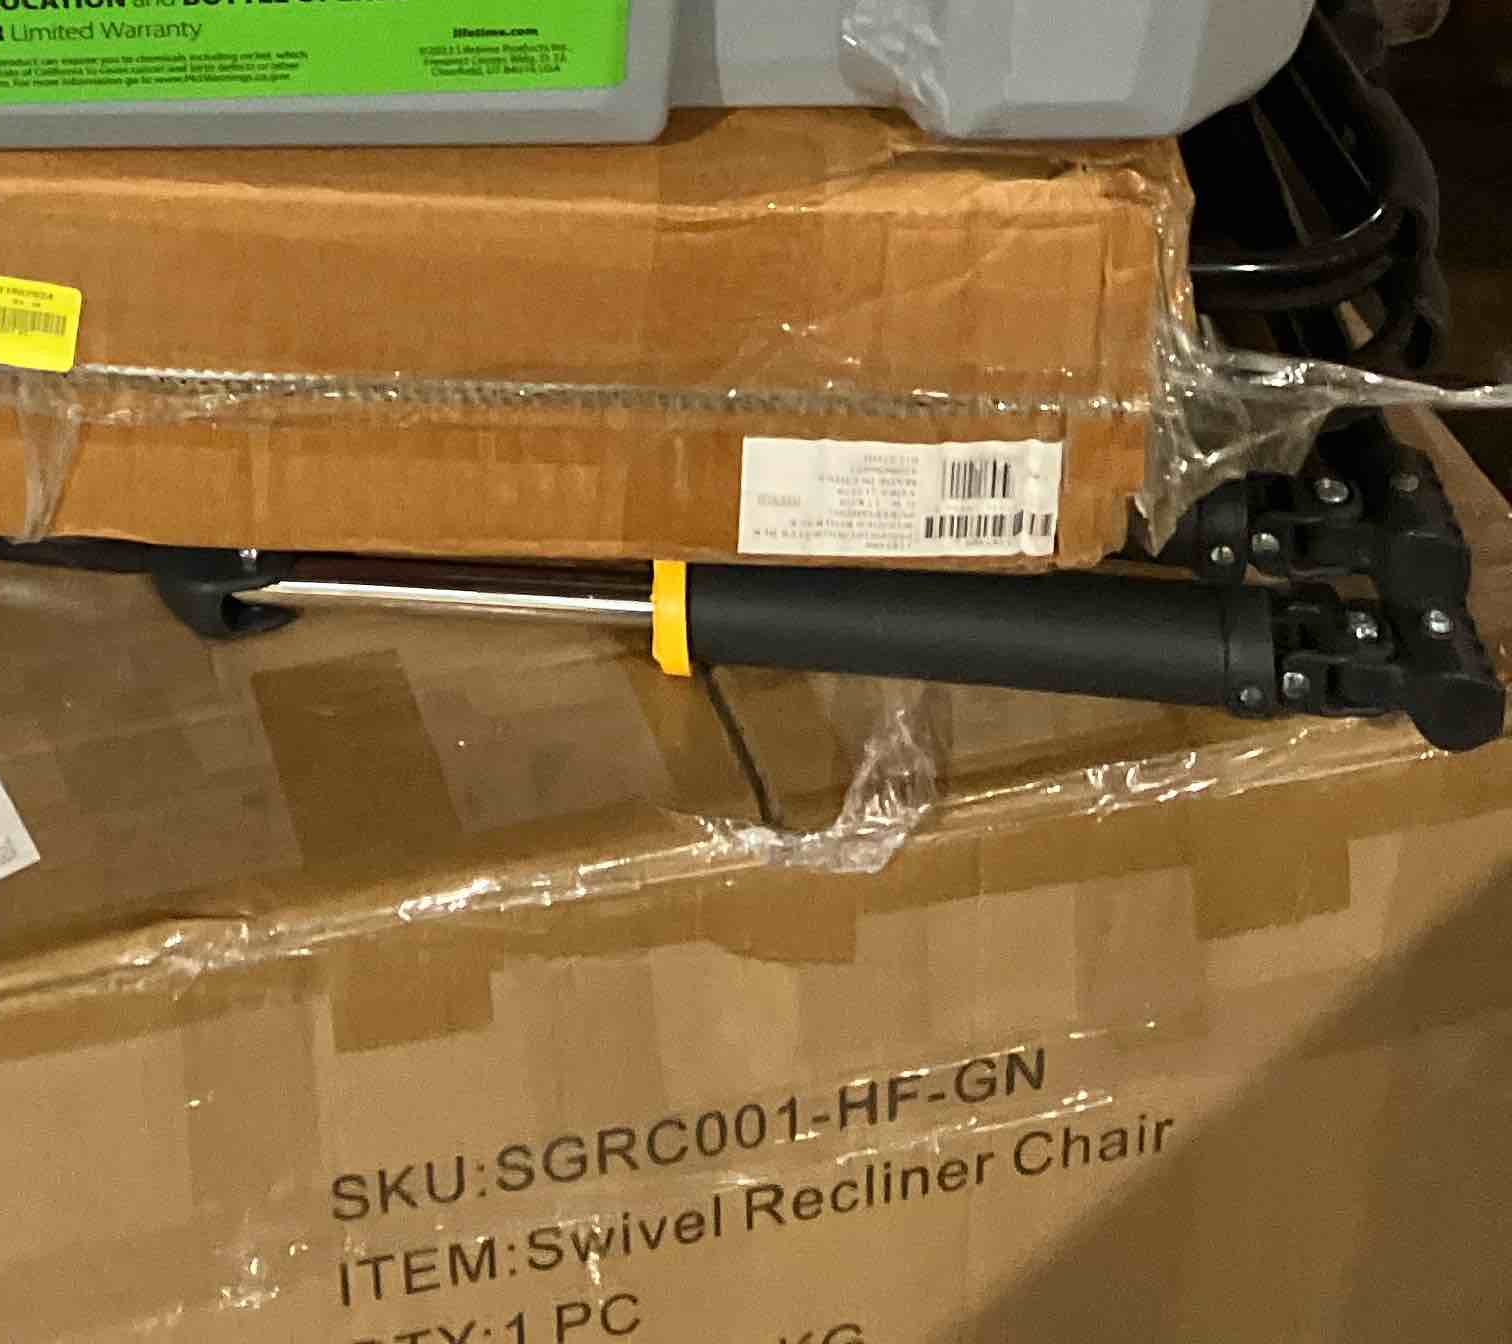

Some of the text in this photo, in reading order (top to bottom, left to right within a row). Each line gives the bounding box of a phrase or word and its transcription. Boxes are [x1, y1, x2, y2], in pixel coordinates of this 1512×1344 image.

[11, 21, 95, 42] Limited
[100, 19, 203, 45] Warranty
[331, 1047, 1047, 1223] SKU:SGRC001-HF-GN
[338, 1112, 1176, 1307] ITEM:Swivel Recliner Chair
[554, 1293, 643, 1344] PC
